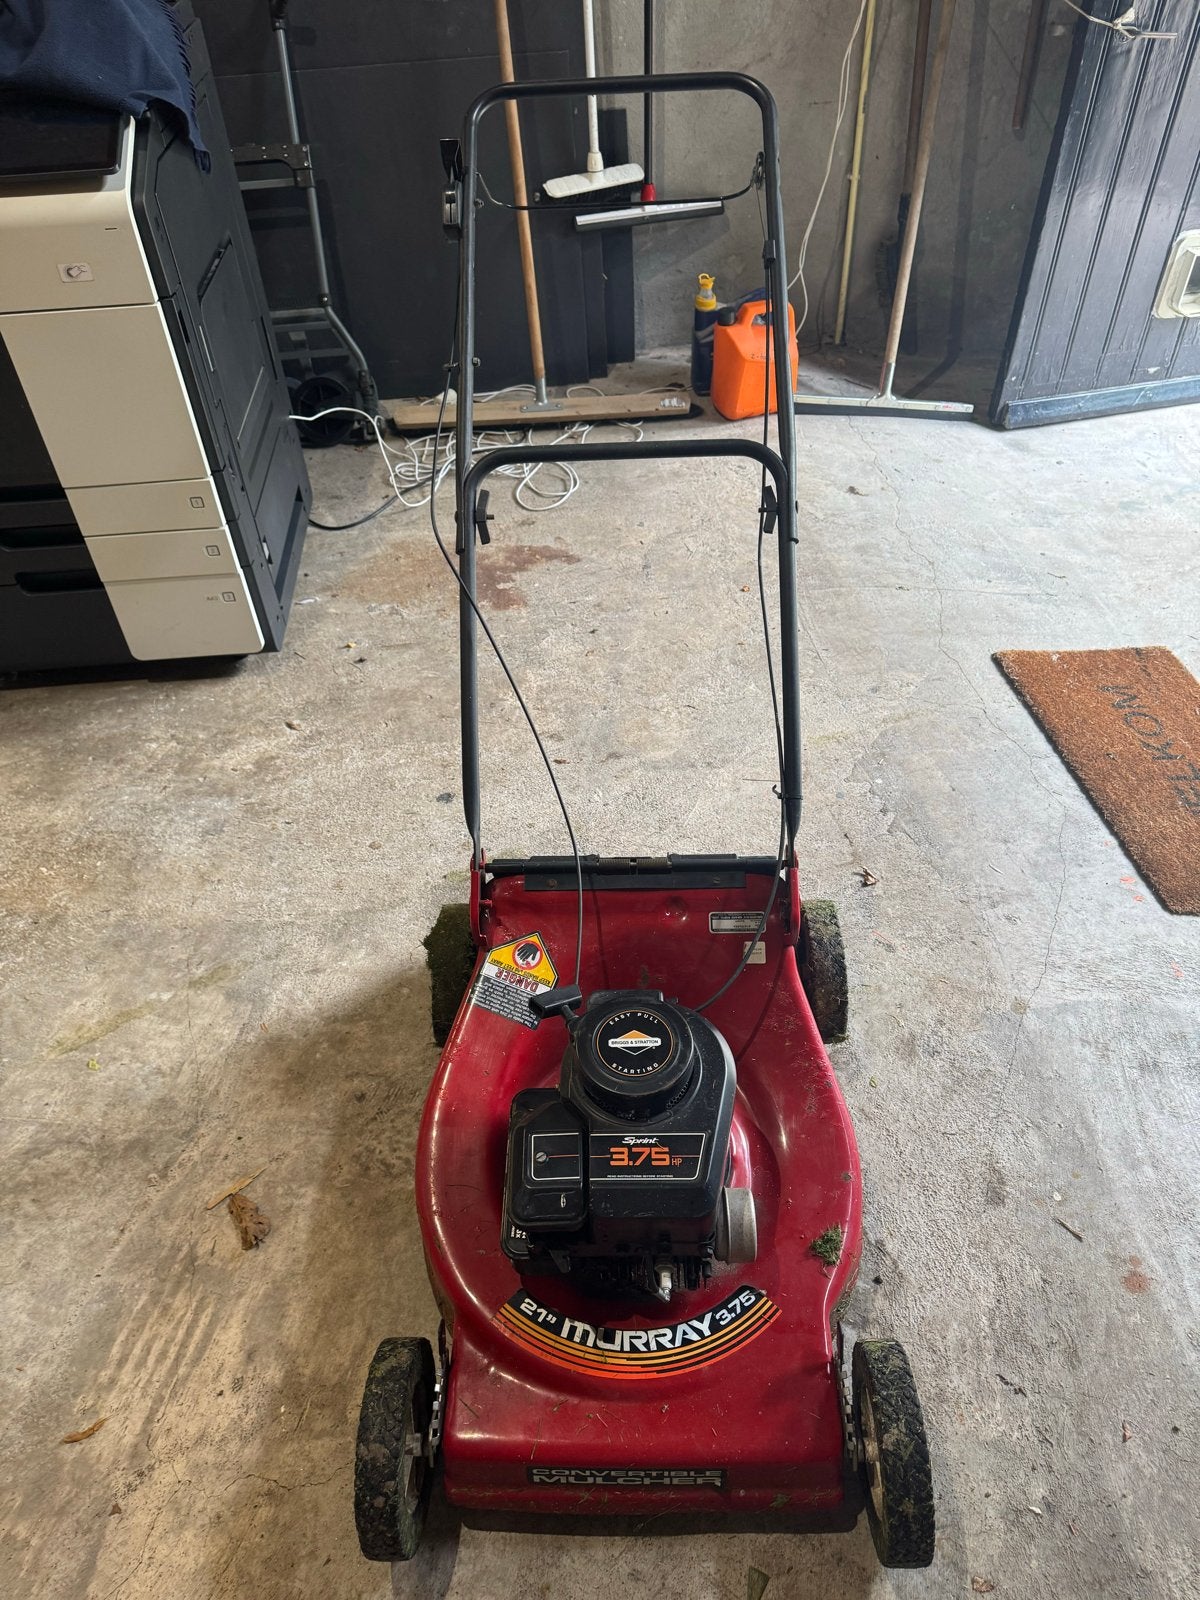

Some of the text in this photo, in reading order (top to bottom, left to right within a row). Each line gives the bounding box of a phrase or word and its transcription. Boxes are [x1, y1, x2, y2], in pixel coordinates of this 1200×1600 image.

[495, 968, 539, 993] DANGER
[538, 977, 551, 986] KEEP
[609, 1012, 659, 1026] EASY PULL
[611, 1062, 659, 1075] STARTING
[622, 1136, 660, 1146] Sprint
[610, 1147, 683, 1168] 3.75 HP
[560, 1311, 713, 1352] MURRAY
[715, 1290, 756, 1326] 3.75
[532, 1468, 722, 1477] CONVERTIBLE
[533, 1475, 722, 1486] MULCHER
